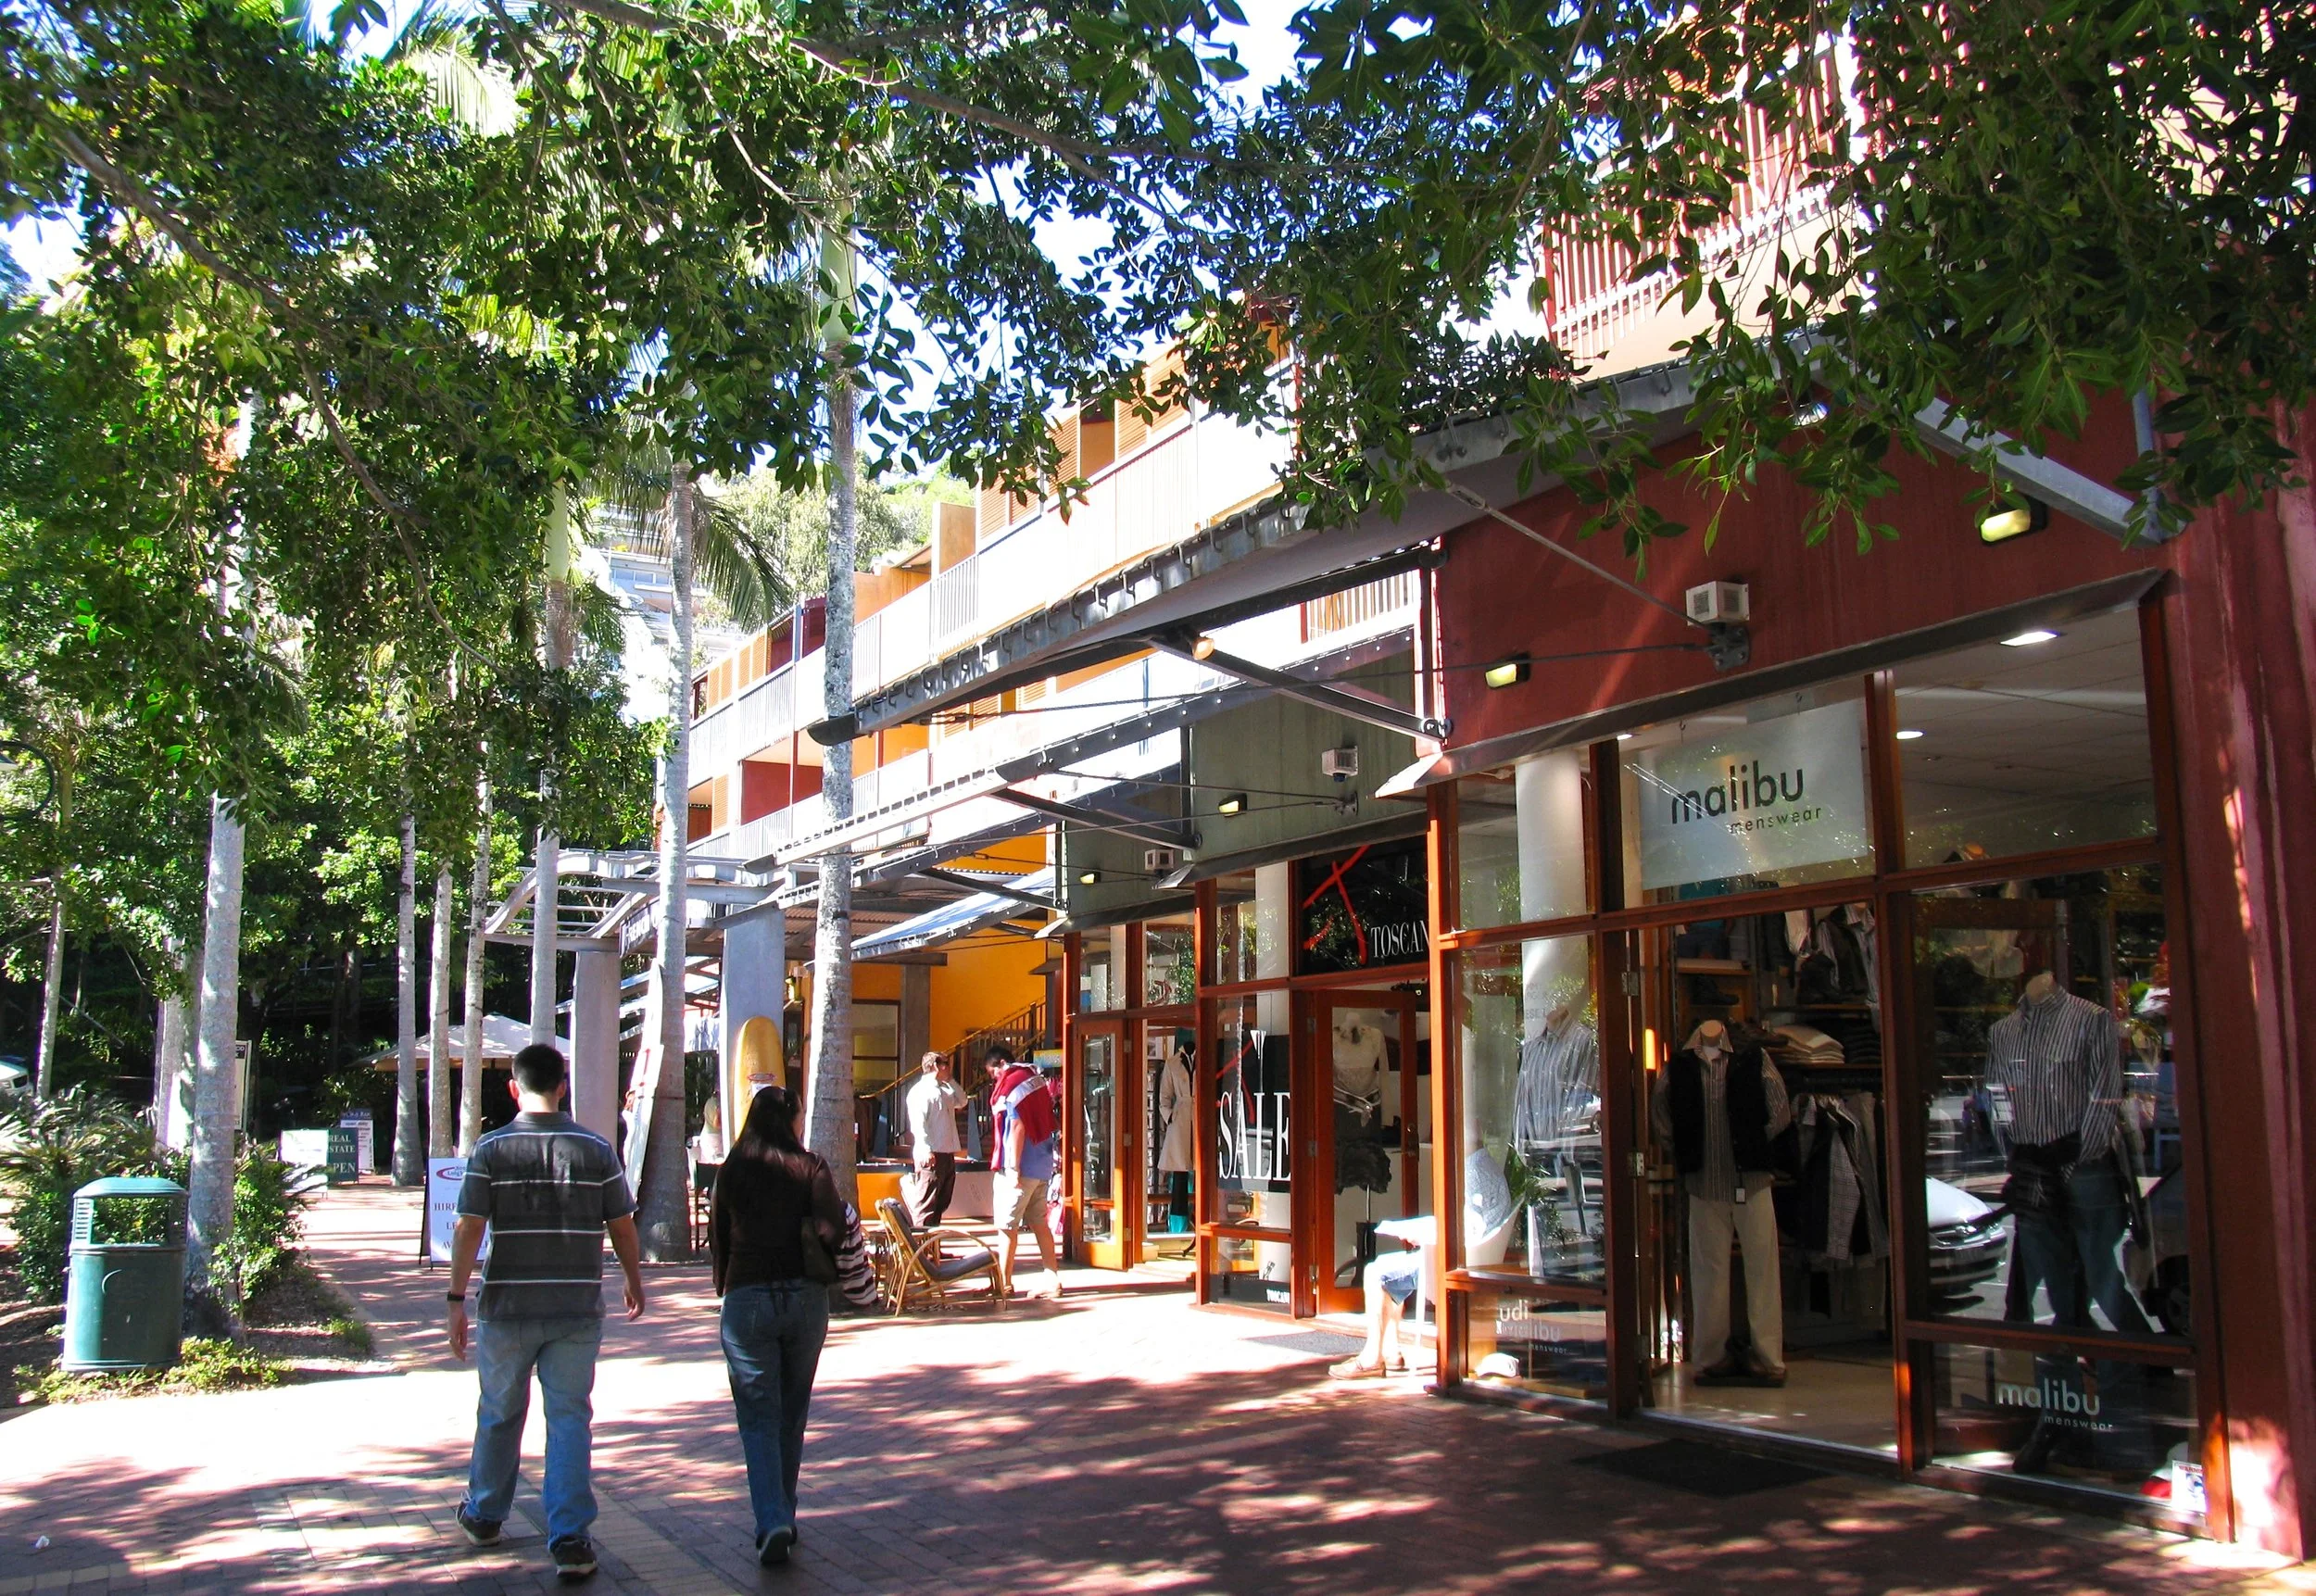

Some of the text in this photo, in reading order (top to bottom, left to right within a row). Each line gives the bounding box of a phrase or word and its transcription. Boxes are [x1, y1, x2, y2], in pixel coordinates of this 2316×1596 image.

[1671, 760, 1805, 824] malibu
[1730, 805, 1822, 834] menswear
[329, 1144, 356, 1153] STATE
[1218, 1090, 1290, 1181] SALE
[333, 1162, 356, 1174] PEN
[1997, 1377, 2101, 1416] malibu
[2045, 1414, 2114, 1432] menswear
